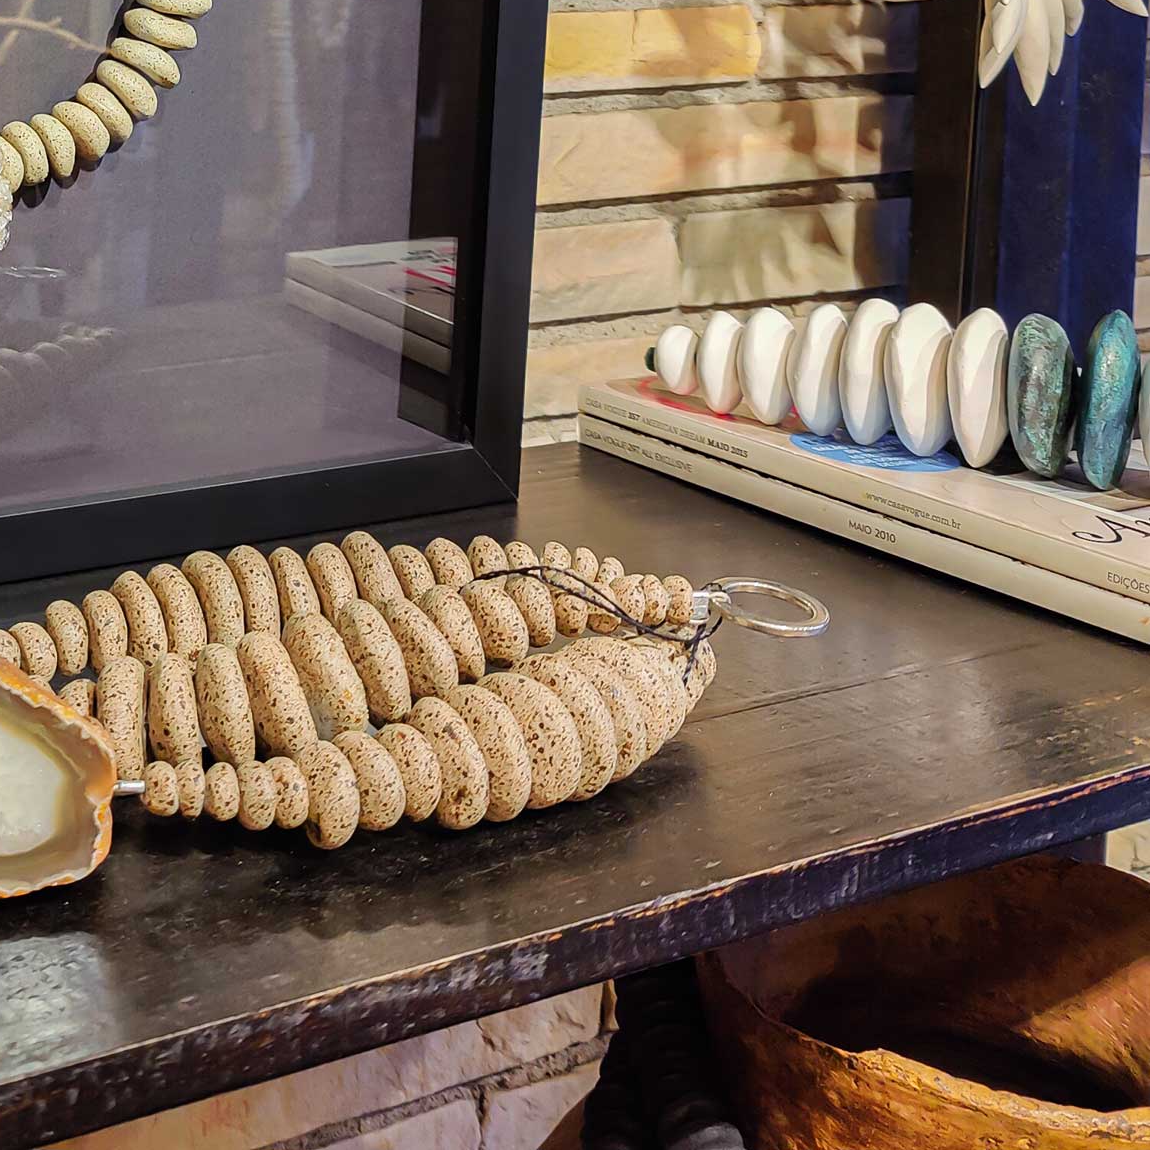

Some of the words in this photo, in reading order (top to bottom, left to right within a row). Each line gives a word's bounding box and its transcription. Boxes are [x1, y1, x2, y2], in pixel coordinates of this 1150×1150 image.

[707, 438, 730, 452] MAIO
[865, 492, 961, 530] www.casavogue.com.br
[849, 519, 872, 535] MAIO
[875, 528, 896, 543] 2010
